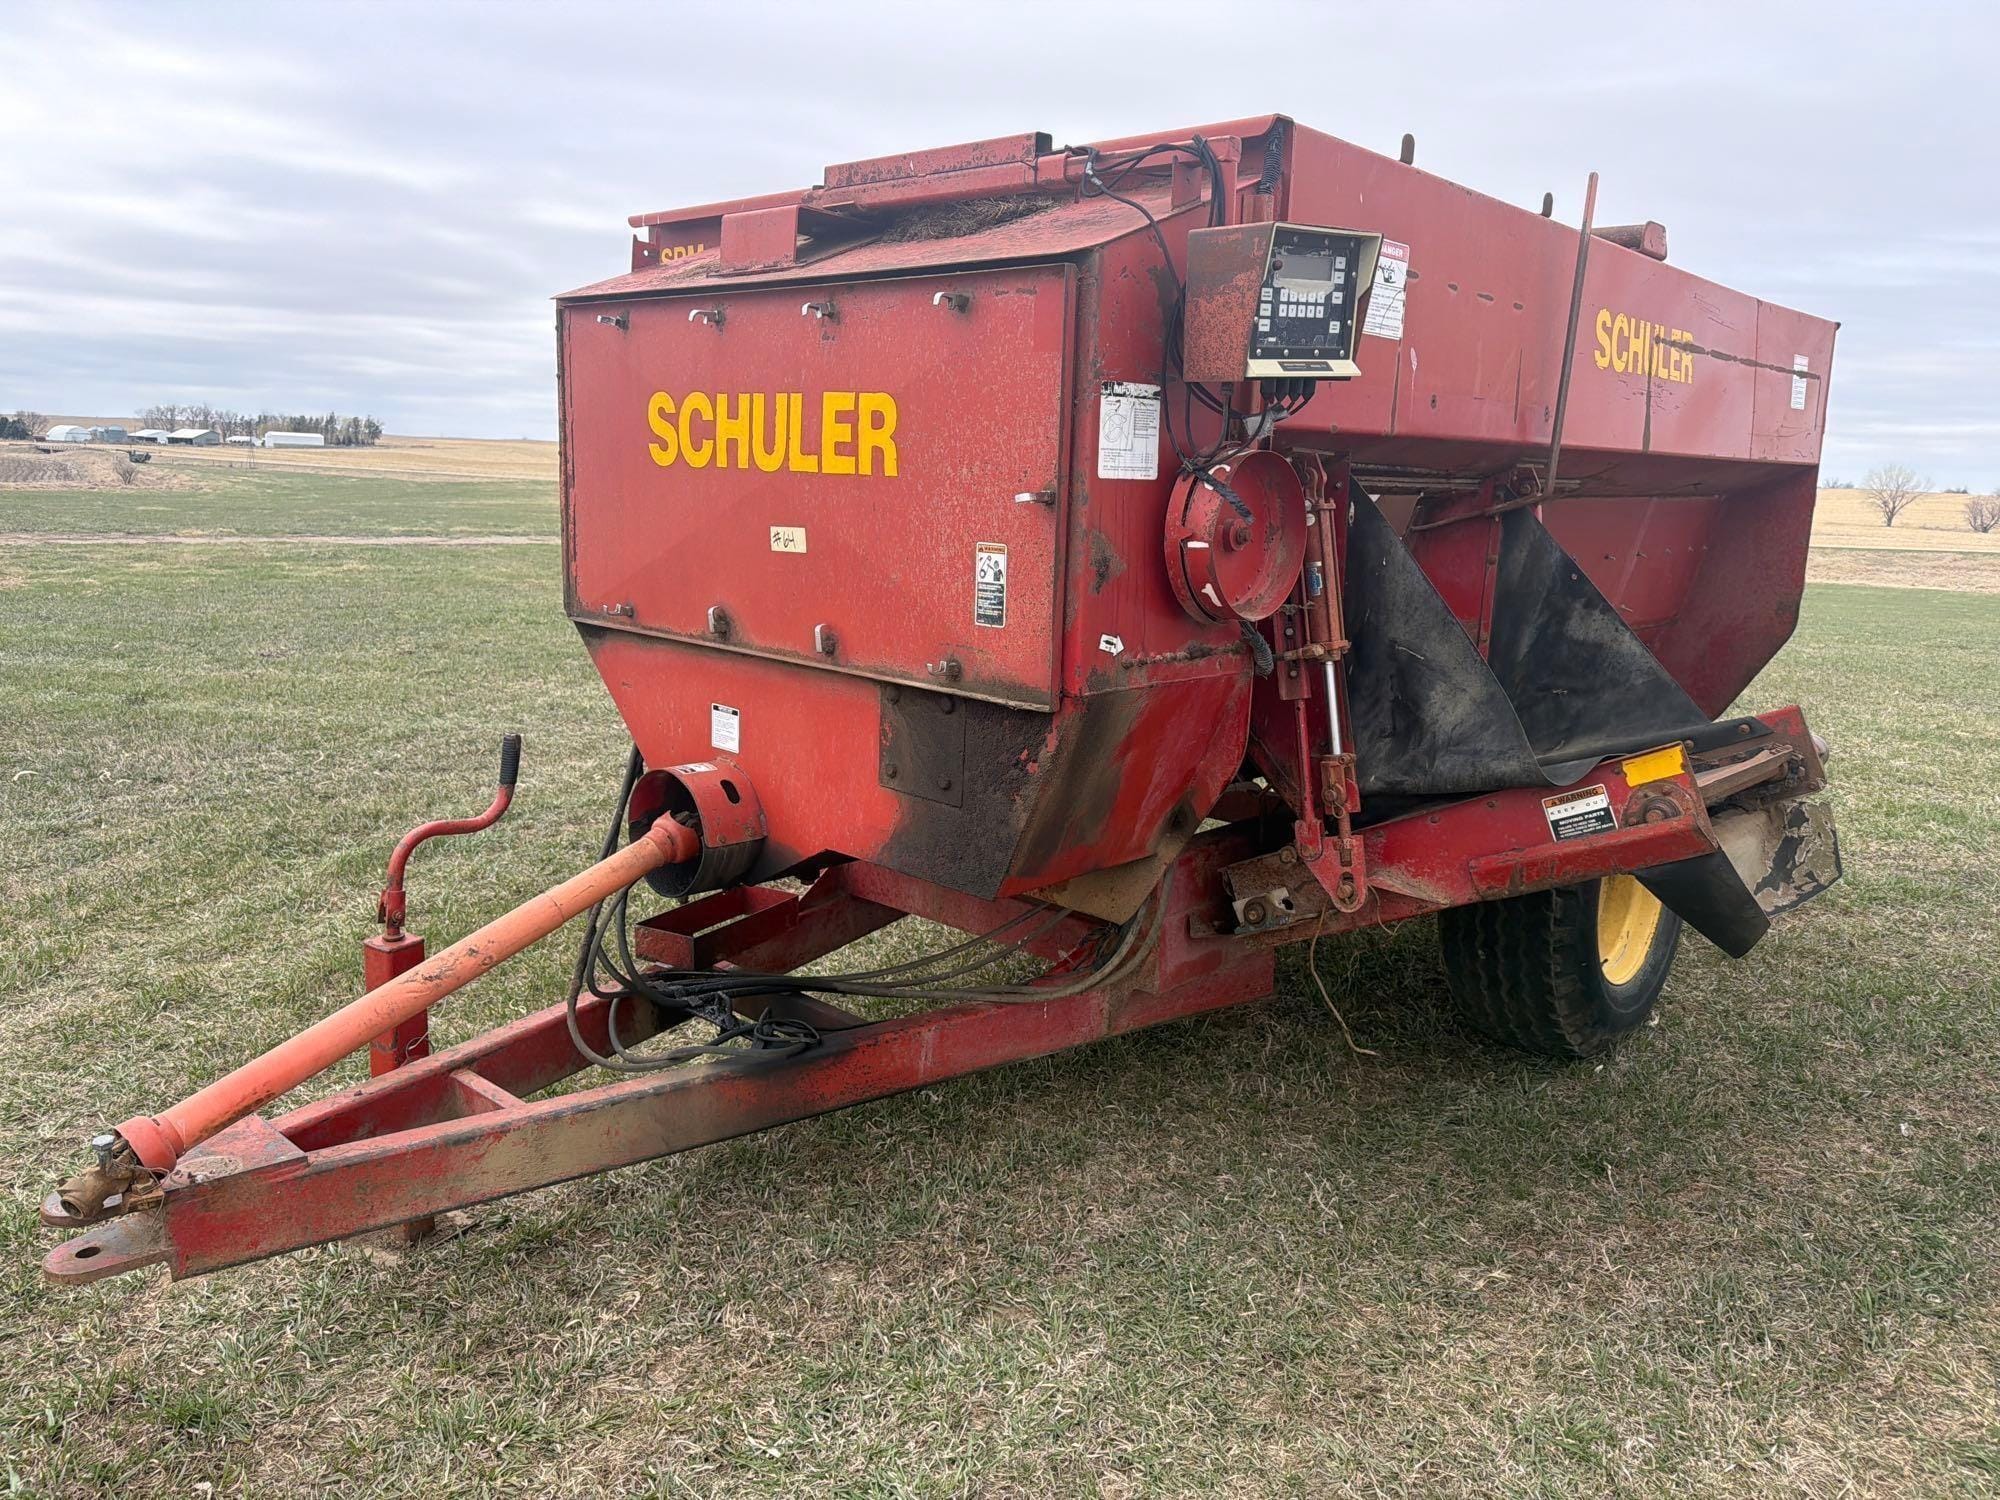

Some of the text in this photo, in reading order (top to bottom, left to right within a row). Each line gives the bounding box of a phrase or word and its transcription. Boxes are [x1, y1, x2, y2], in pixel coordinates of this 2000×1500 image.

[1382, 244, 1404, 258] ANGER
[1593, 307, 1694, 384] SCHULER
[647, 390, 899, 478] SCHULER
[1559, 789, 1598, 803] WARNING
[1550, 806, 1576, 815] KEEP
[1559, 811, 1604, 825] MOVING PARTS
